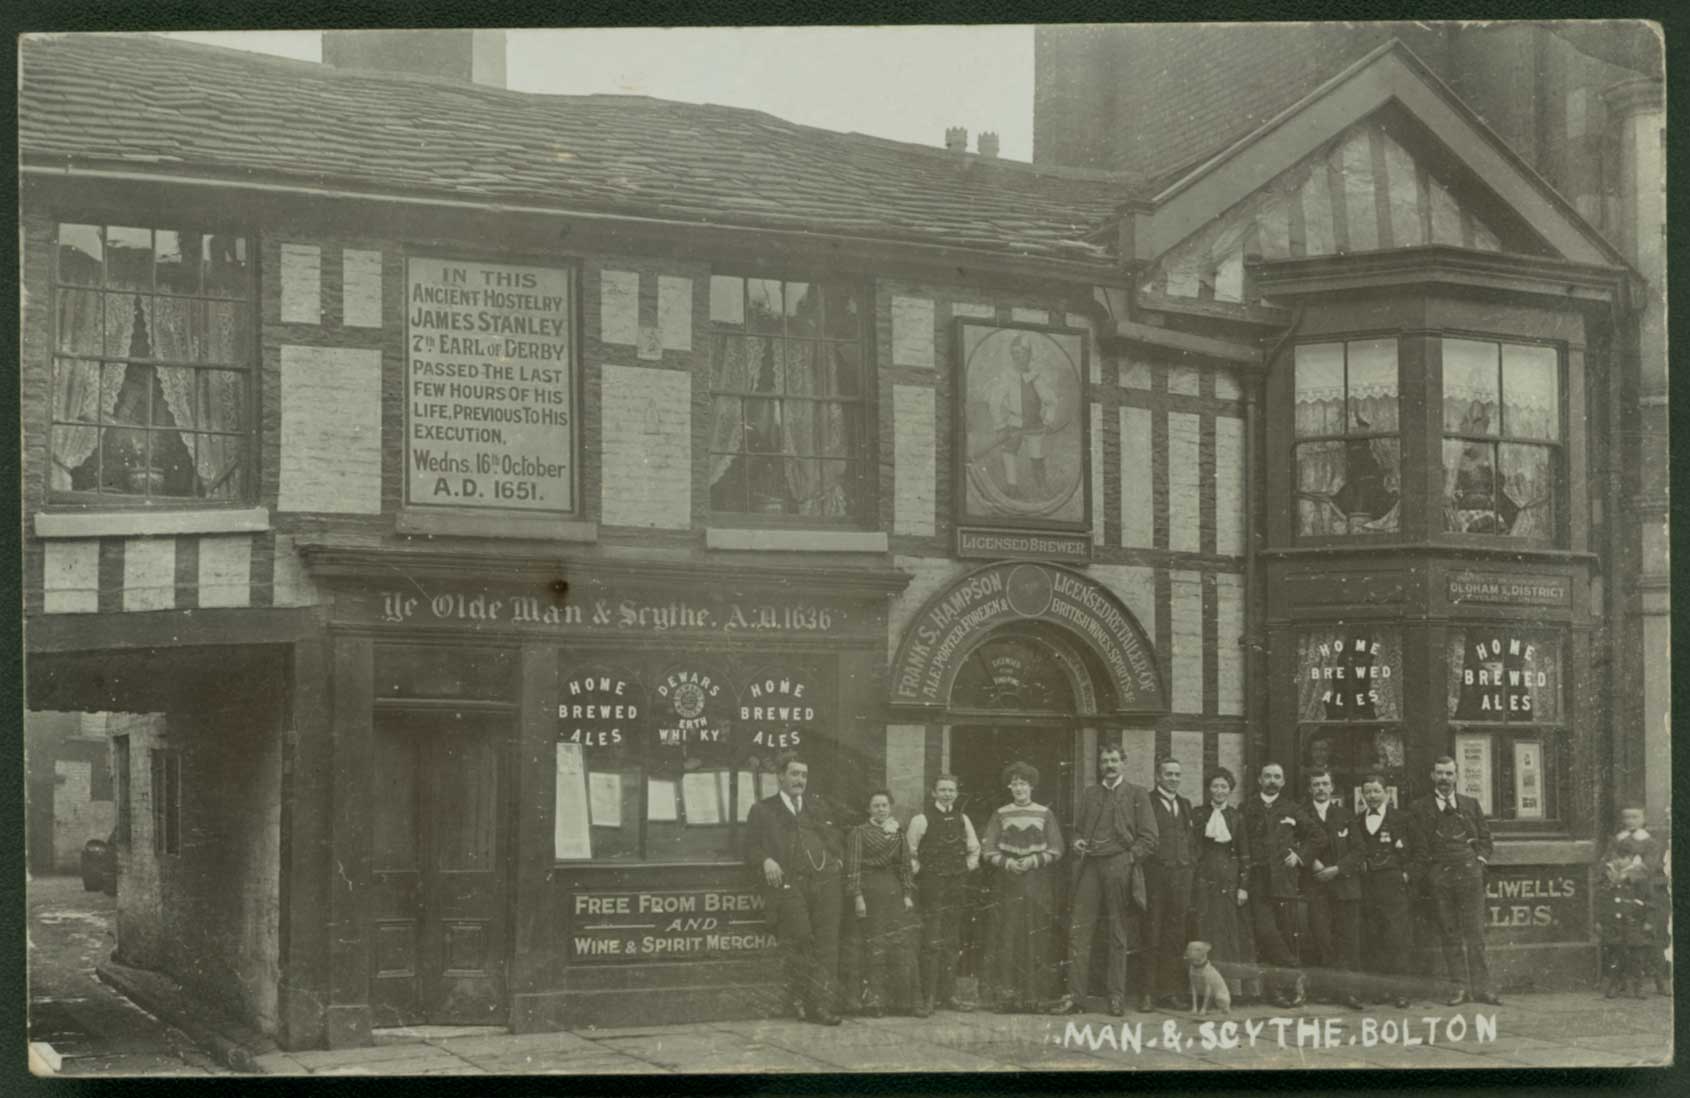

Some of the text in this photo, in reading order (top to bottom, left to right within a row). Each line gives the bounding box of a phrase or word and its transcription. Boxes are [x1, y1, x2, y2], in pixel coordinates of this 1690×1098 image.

[442, 267, 538, 289] IN THIS
[413, 283, 563, 312] ANCIENT HOSTELRY
[411, 307, 565, 337] JAMES STANLEY
[439, 334, 484, 356] EARL
[505, 339, 564, 361] DERBY
[413, 360, 562, 383] PASSED THE LAST
[413, 381, 563, 405] FEW HOURS OF HIS
[453, 403, 522, 423] PREVIOUS
[522, 407, 540, 424] TO
[542, 408, 568, 426] HIS
[501, 453, 566, 478] October
[433, 478, 544, 501] A.D. 1651.
[962, 533, 1029, 551] LICENSED
[1450, 581, 1499, 595] OLDHAM
[1511, 584, 1566, 598] DISTRICT
[382, 591, 418, 623] Ye
[431, 592, 503, 620] Olde
[511, 596, 582, 625] Man
[592, 598, 611, 624] &
[785, 605, 832, 631] 1636
[1051, 597, 1092, 629] BRITISH
[1054, 571, 1111, 620] LICENSED
[1105, 608, 1149, 675] RETAILER
[897, 640, 931, 698] FRANK
[929, 570, 1002, 630] HAMPSON
[1319, 639, 1381, 657] HOME
[1476, 638, 1535, 661] HOME
[1311, 665, 1391, 679] BREWED
[1464, 669, 1546, 687] BREWED
[569, 677, 626, 695] HOME
[656, 671, 720, 698] DEWARS
[750, 679, 805, 698] HOME
[1322, 690, 1379, 706] ALES
[1481, 694, 1531, 711] ALES
[559, 704, 637, 719] BREWED
[678, 715, 708, 729] ERTH
[741, 706, 814, 720] BREWED
[570, 729, 622, 746] ALES
[658, 728, 721, 743] WHIKY
[753, 731, 801, 747] ALES
[1485, 877, 1576, 899] LIWELL'S
[575, 893, 766, 914] FREE FROM BREW
[664, 917, 718, 932] AND
[1484, 905, 1560, 927] LES.
[574, 934, 778, 955] WINE & SPIRIT MERCHA
